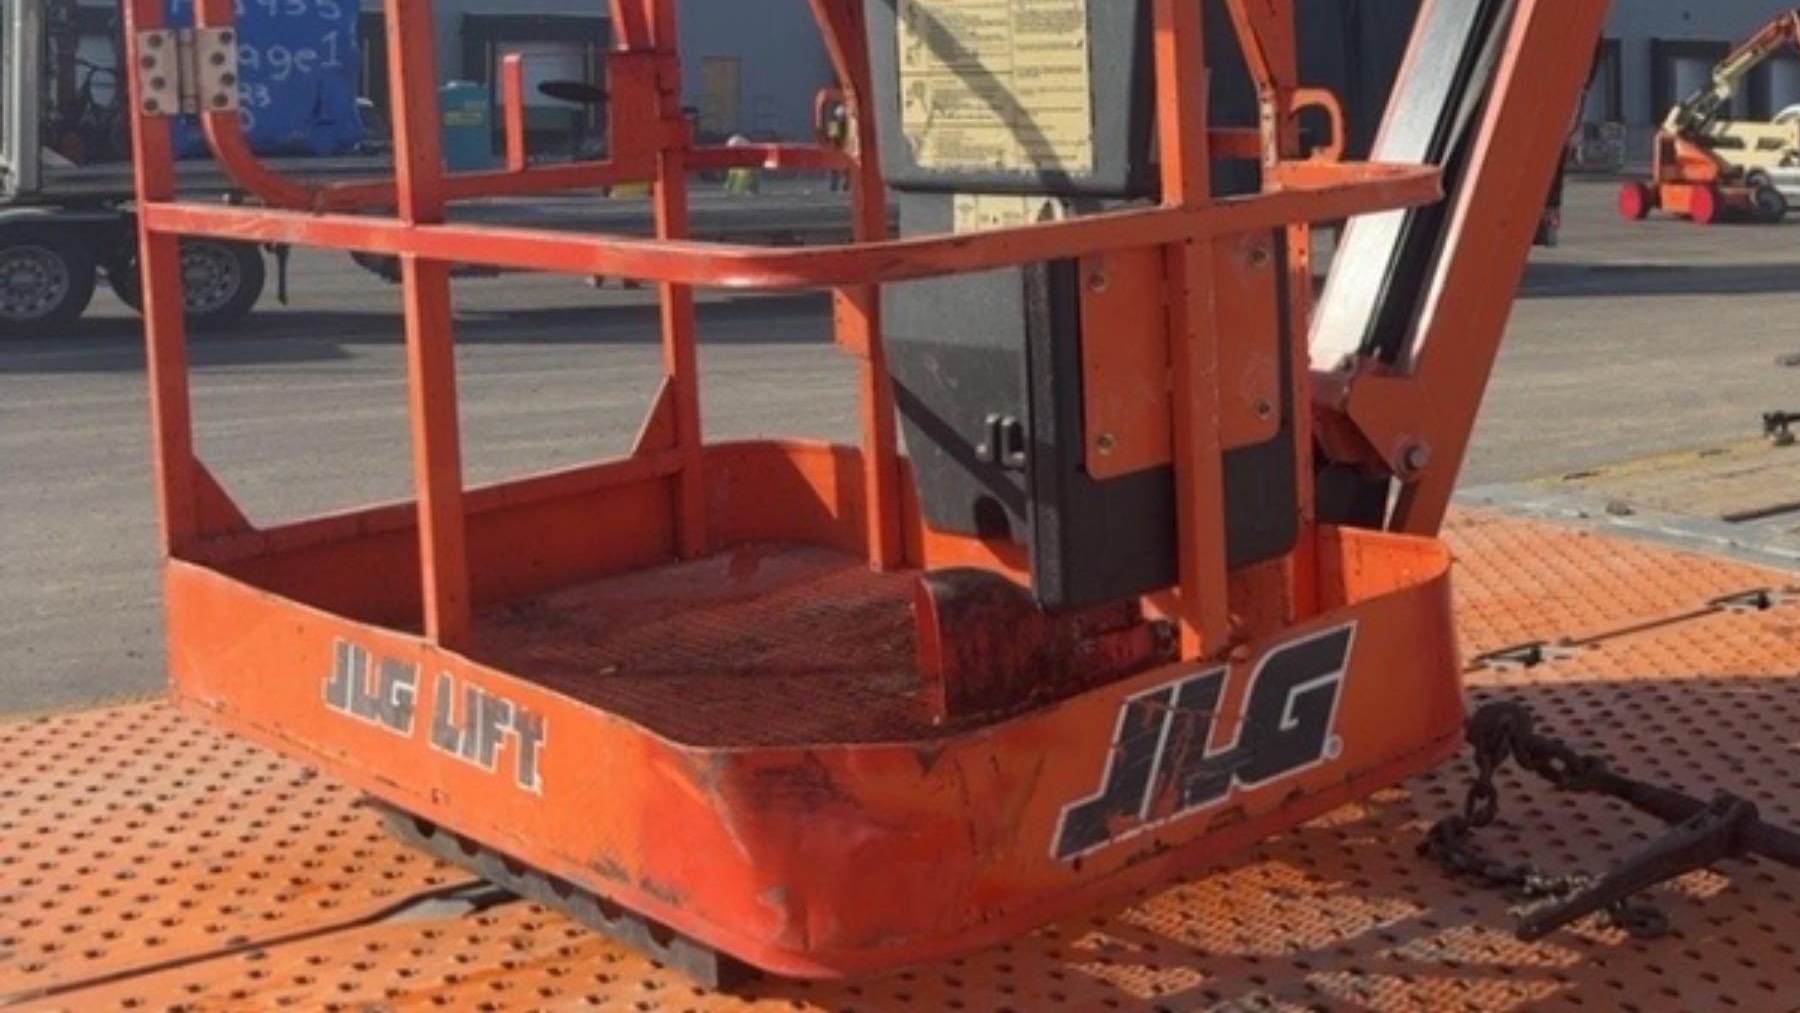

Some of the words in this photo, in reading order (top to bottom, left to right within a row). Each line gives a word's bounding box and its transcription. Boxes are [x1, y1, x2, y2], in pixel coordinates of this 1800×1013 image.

[321, 636, 421, 739] JLG
[428, 670, 548, 794] LIFT
[1050, 620, 1358, 861] JLG
